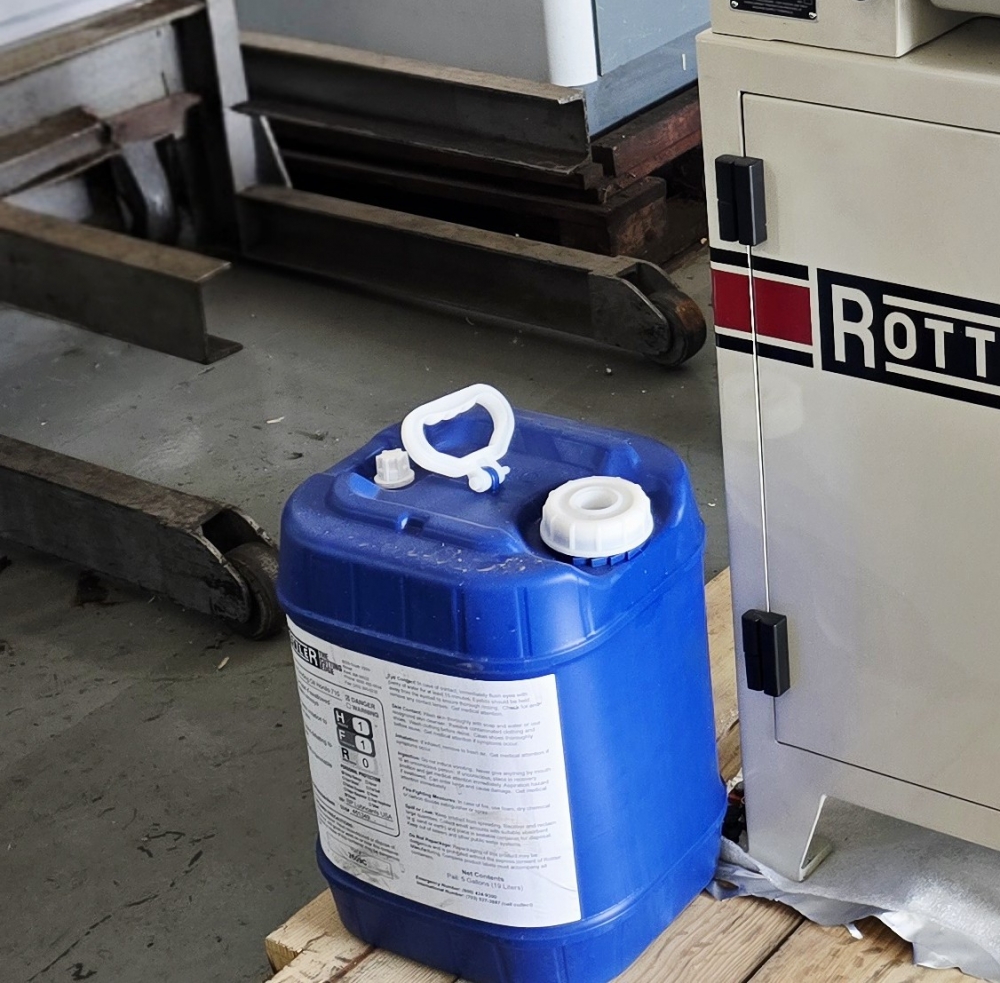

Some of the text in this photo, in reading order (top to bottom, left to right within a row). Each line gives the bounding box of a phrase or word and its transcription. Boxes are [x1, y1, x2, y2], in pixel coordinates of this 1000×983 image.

[336, 711, 345, 724] H
[357, 721, 363, 732] 1
[360, 740, 365, 750] 1
[341, 747, 349, 761] R
[415, 875, 440, 886] Emergency
[474, 871, 505, 882] Contents
[416, 880, 444, 892] International
[466, 877, 490, 887] Gallons
[502, 883, 523, 892] Liters)
